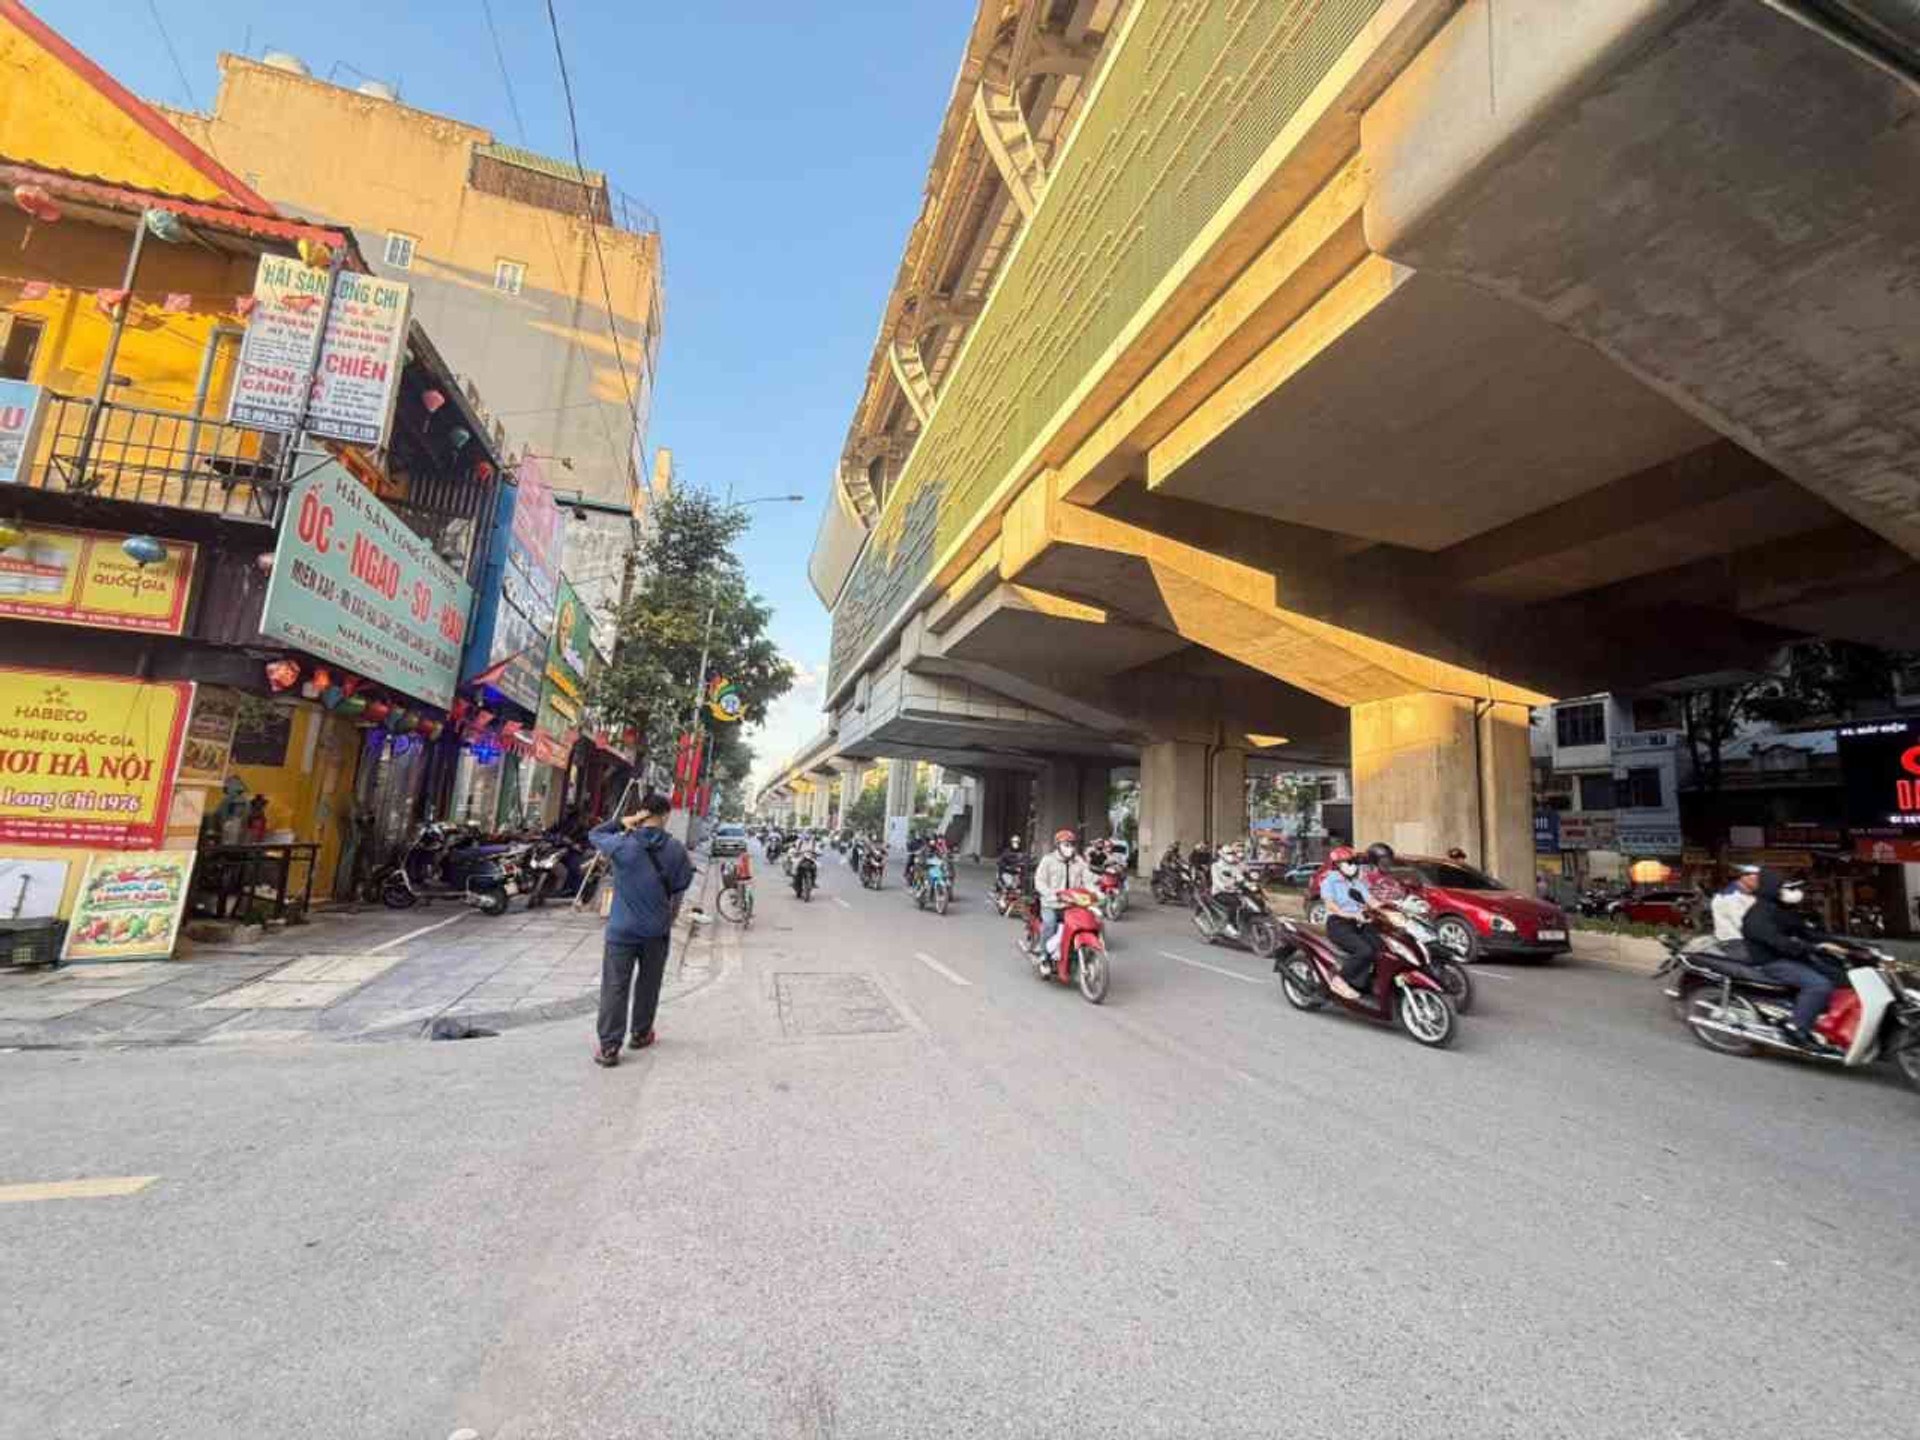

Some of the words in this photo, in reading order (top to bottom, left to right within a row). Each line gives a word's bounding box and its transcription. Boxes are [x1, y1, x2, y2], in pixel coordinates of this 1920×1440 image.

[298, 481, 335, 554] ỐC
[350, 529, 401, 602] NGAO
[14, 706, 88, 723] HABECO
[24, 730, 60, 743] HIỆU
[62, 729, 107, 745] QUỐC
[110, 734, 136, 747] GIA
[48, 749, 91, 778] HÀ
[97, 753, 156, 788] NỘI
[3, 786, 56, 812] Long
[99, 793, 142, 813] 1976
